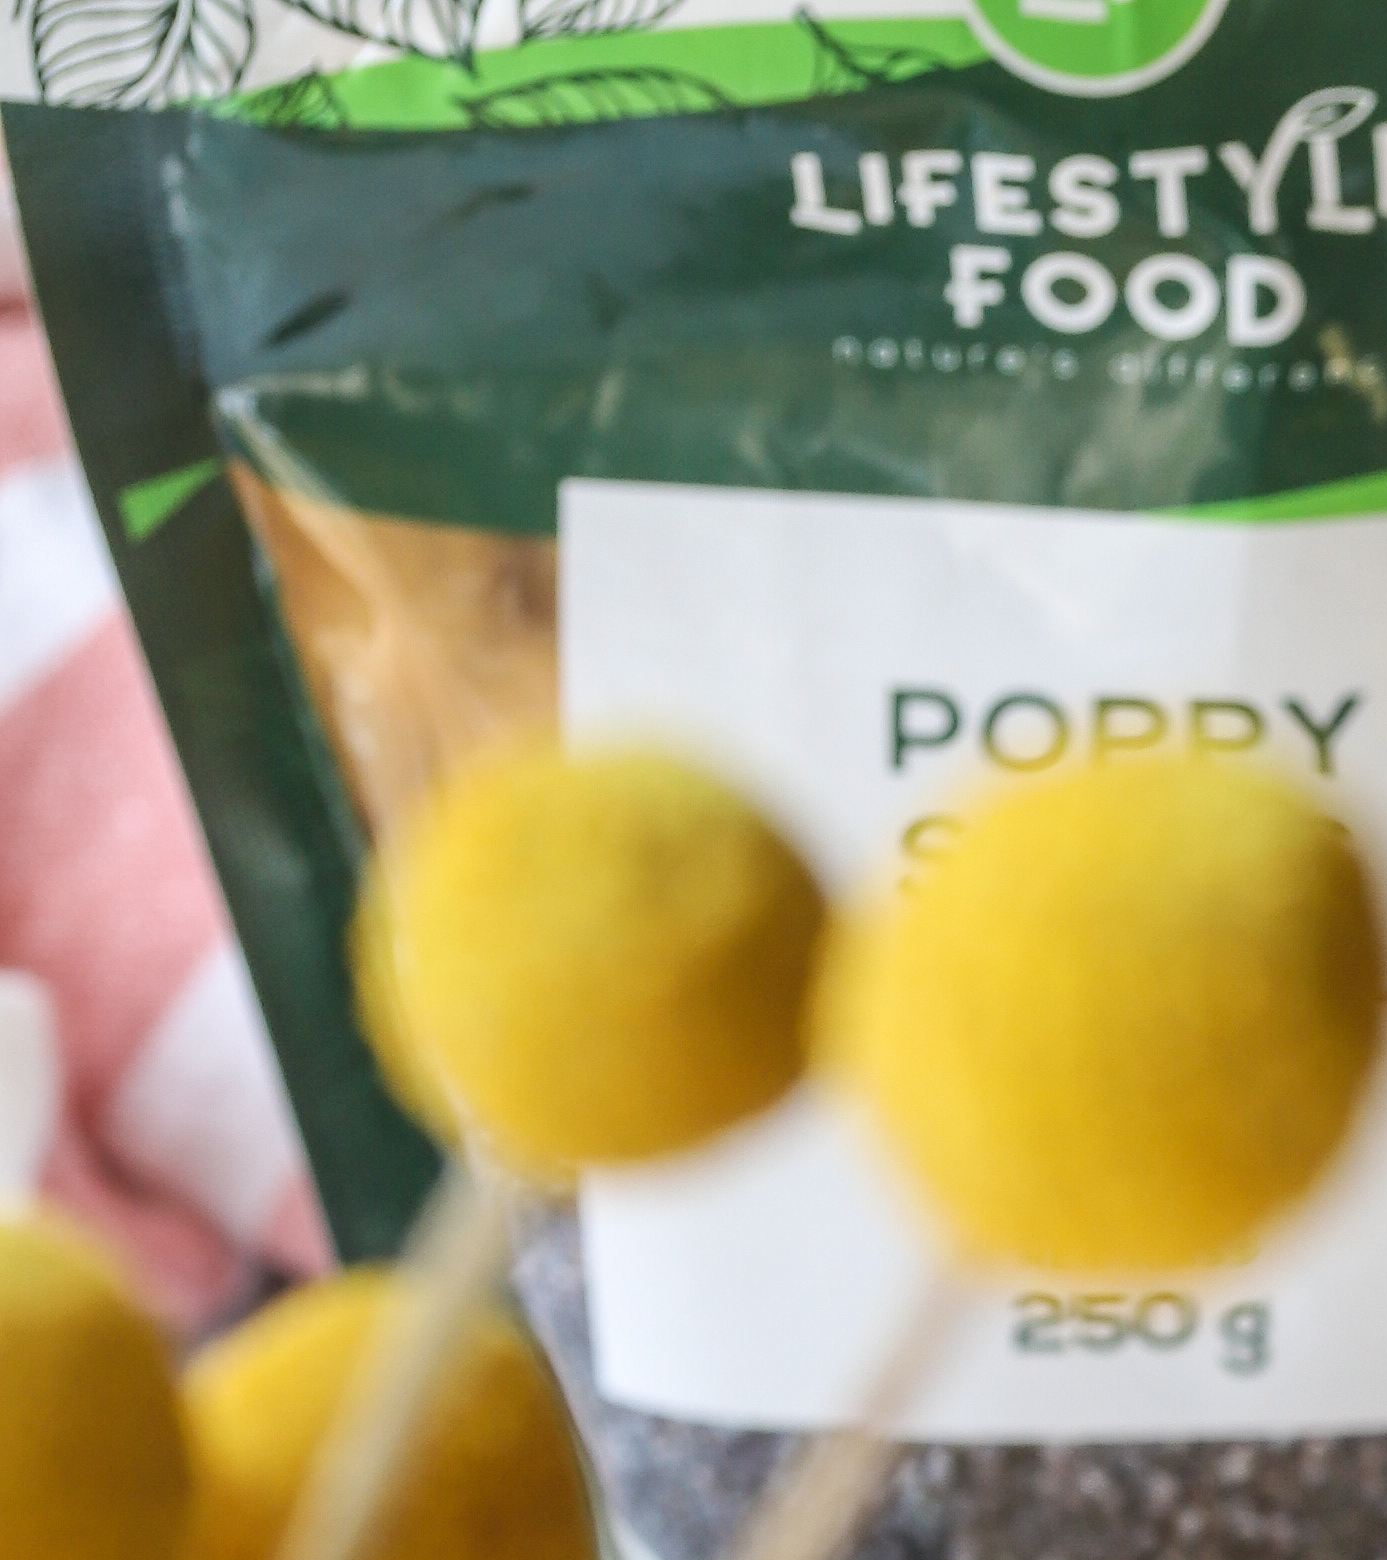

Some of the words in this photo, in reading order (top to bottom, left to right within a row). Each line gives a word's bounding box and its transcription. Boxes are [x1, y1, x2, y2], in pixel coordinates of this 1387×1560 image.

[945, 244, 1306, 346] FOOD
[889, 688, 1360, 774] POPPY
[1010, 1291, 1200, 1354] 250
[1217, 1302, 1271, 1378] g
